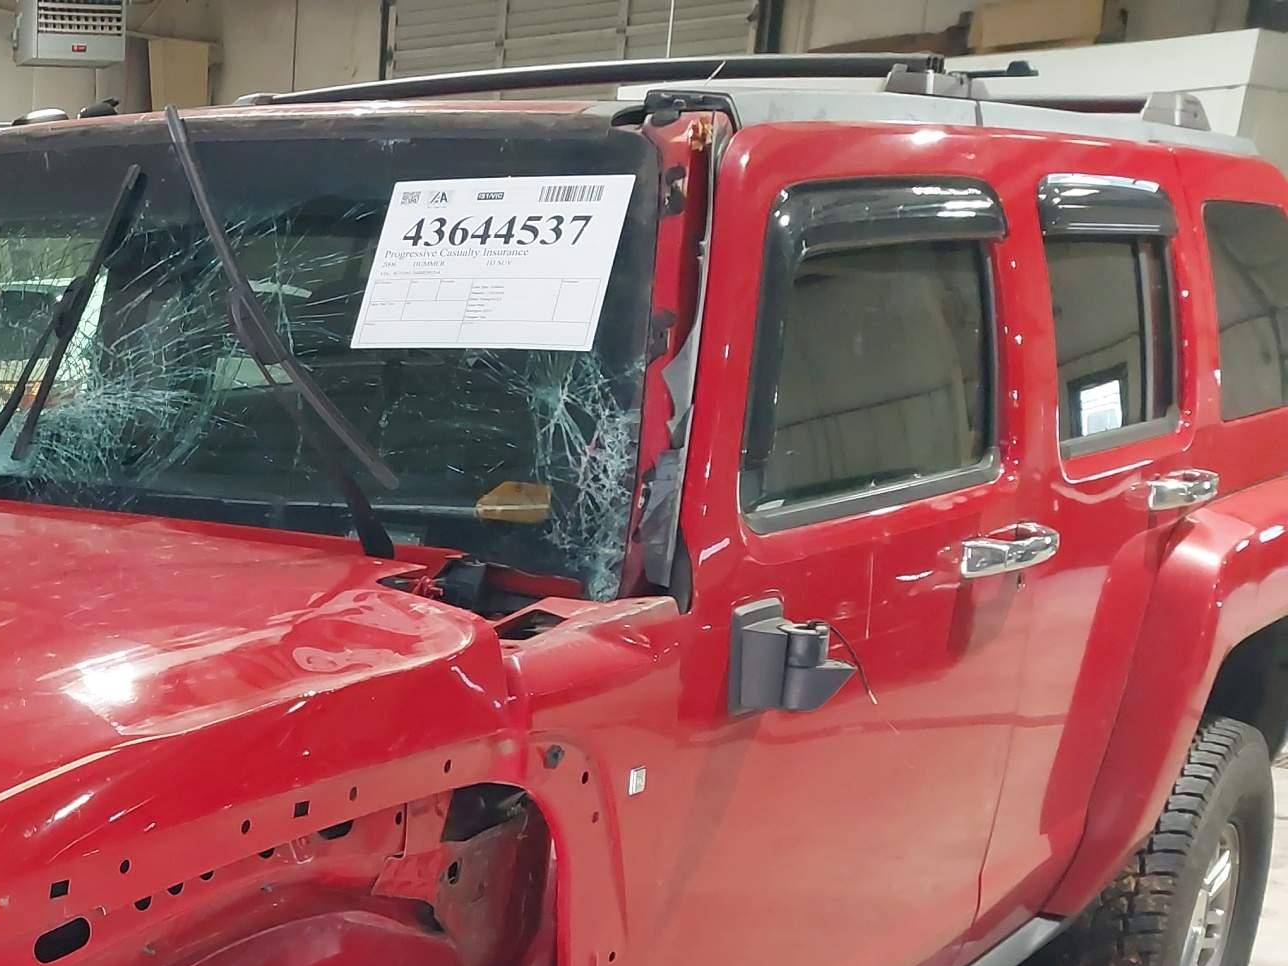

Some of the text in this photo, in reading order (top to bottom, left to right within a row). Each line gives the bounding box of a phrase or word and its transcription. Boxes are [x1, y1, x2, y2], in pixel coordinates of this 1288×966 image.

[403, 215, 593, 246] 43644537
[385, 247, 529, 260] Progressive Casualty Insurance
